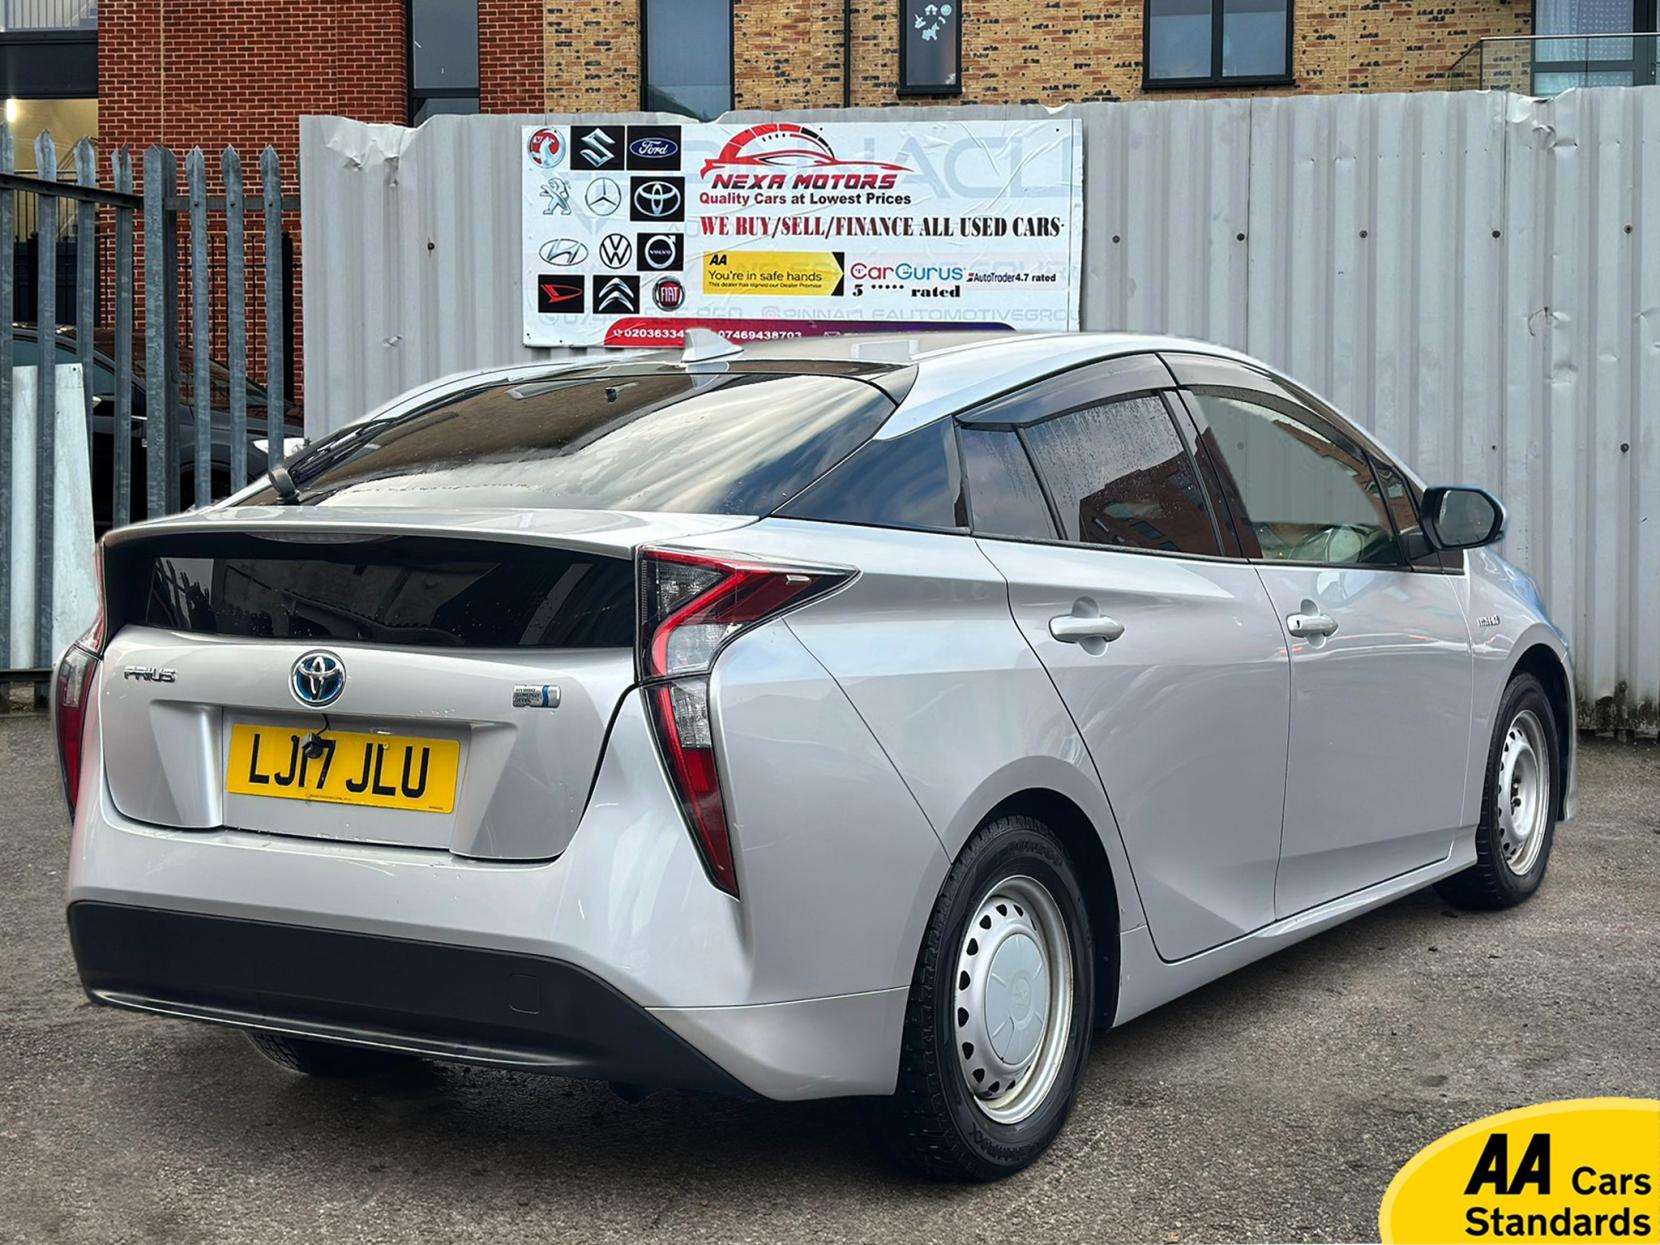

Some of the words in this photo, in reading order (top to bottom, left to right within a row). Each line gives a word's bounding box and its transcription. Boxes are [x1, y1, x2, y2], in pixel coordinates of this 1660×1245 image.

[638, 140, 669, 155] Ford
[711, 174, 786, 189] NEXA
[792, 174, 898, 189] MOTORS
[700, 192, 750, 206] Quality
[754, 192, 786, 204] Cars
[791, 193, 806, 204] at
[810, 192, 862, 205] Lowest
[866, 192, 911, 205] Prices
[700, 216, 729, 235] WE
[919, 217, 954, 236] ALL
[960, 217, 1007, 236] USED
[1012, 216, 1061, 236] CARS
[709, 254, 727, 266] AA
[708, 270, 744, 281] You're
[747, 271, 757, 280] in
[760, 270, 784, 281] safe
[787, 271, 823, 282] hands
[851, 262, 963, 280] CarGurus
[1031, 273, 1056, 282] rated
[660, 286, 681, 303] FIAT
[852, 284, 863, 296] 5
[911, 285, 960, 297] rated
[124, 665, 176, 683] PRIUS
[248, 733, 337, 789] LJ17
[345, 742, 431, 798] JLU
